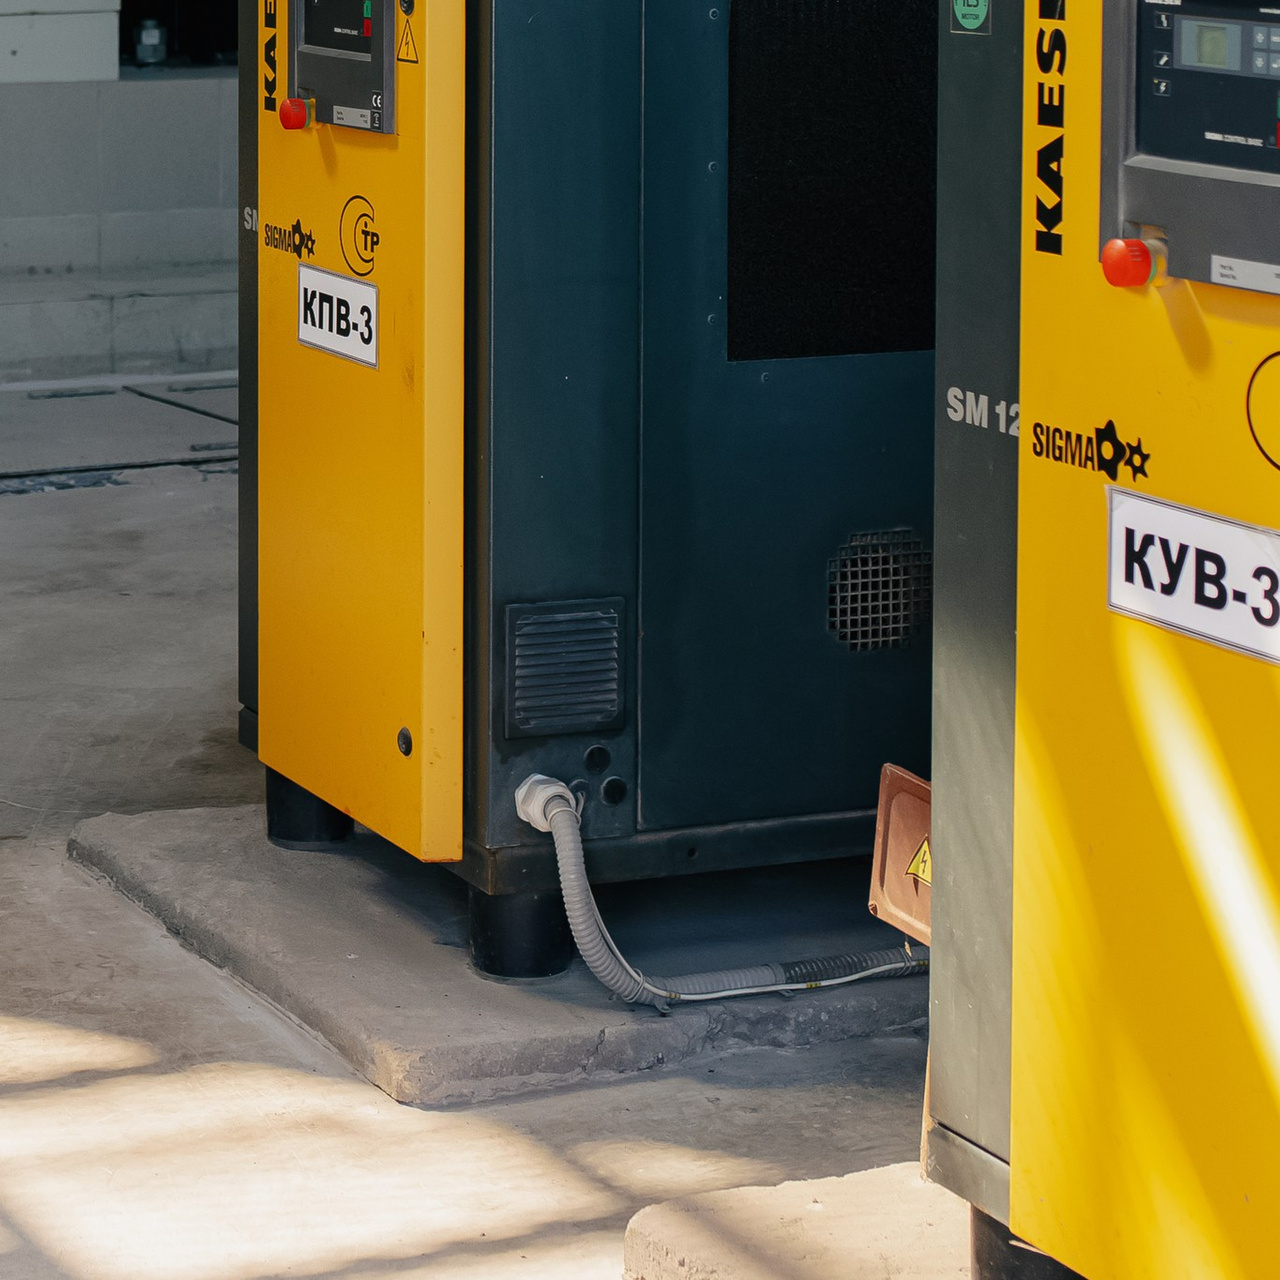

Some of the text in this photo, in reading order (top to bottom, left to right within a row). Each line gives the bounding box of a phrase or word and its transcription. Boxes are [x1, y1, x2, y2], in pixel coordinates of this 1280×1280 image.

[265, 223, 293, 253] SIGMA
[302, 286, 373, 346] КПВ-3
[946, 386, 989, 429] SM
[1032, 421, 1099, 472] SIGMA
[1123, 526, 1280, 628] КУВ-3
